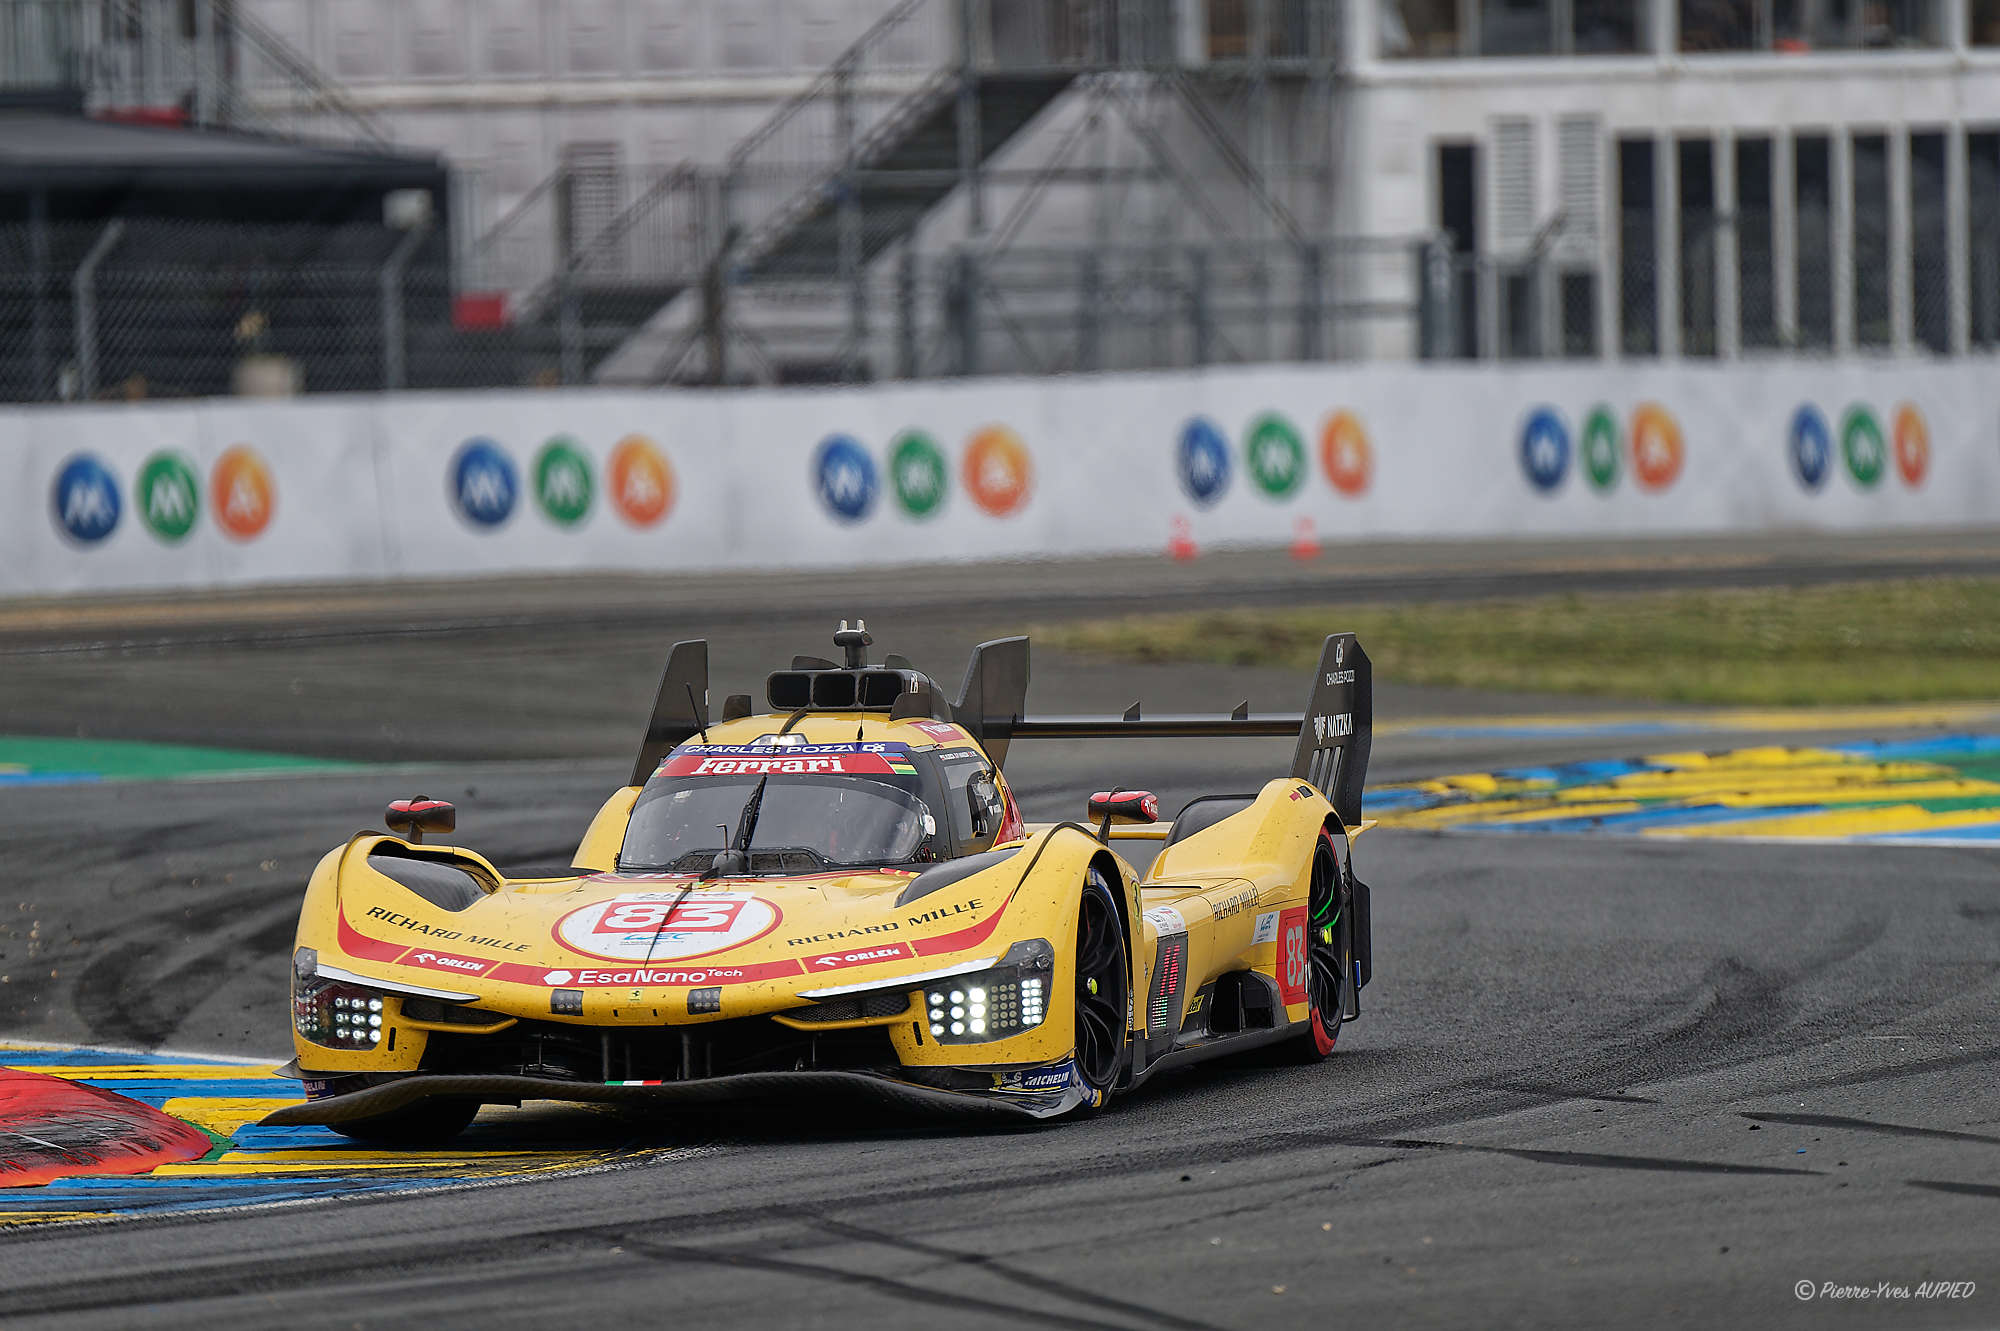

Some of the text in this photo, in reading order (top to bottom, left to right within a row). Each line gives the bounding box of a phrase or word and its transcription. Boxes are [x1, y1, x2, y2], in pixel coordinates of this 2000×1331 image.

[685, 744, 855, 754] CHARLES POZZI
[690, 756, 845, 774] Ferrari
[604, 903, 734, 929] 83
[1213, 890, 1240, 921] RICHARD
[366, 906, 532, 953] RICHARD MILLE
[787, 898, 984, 946] RICHARD MILLE
[436, 957, 484, 971] ORLEN
[845, 948, 900, 962] ORLEN
[1286, 925, 1304, 987] 83
[1025, 1071, 1070, 1086] MICHELIN
